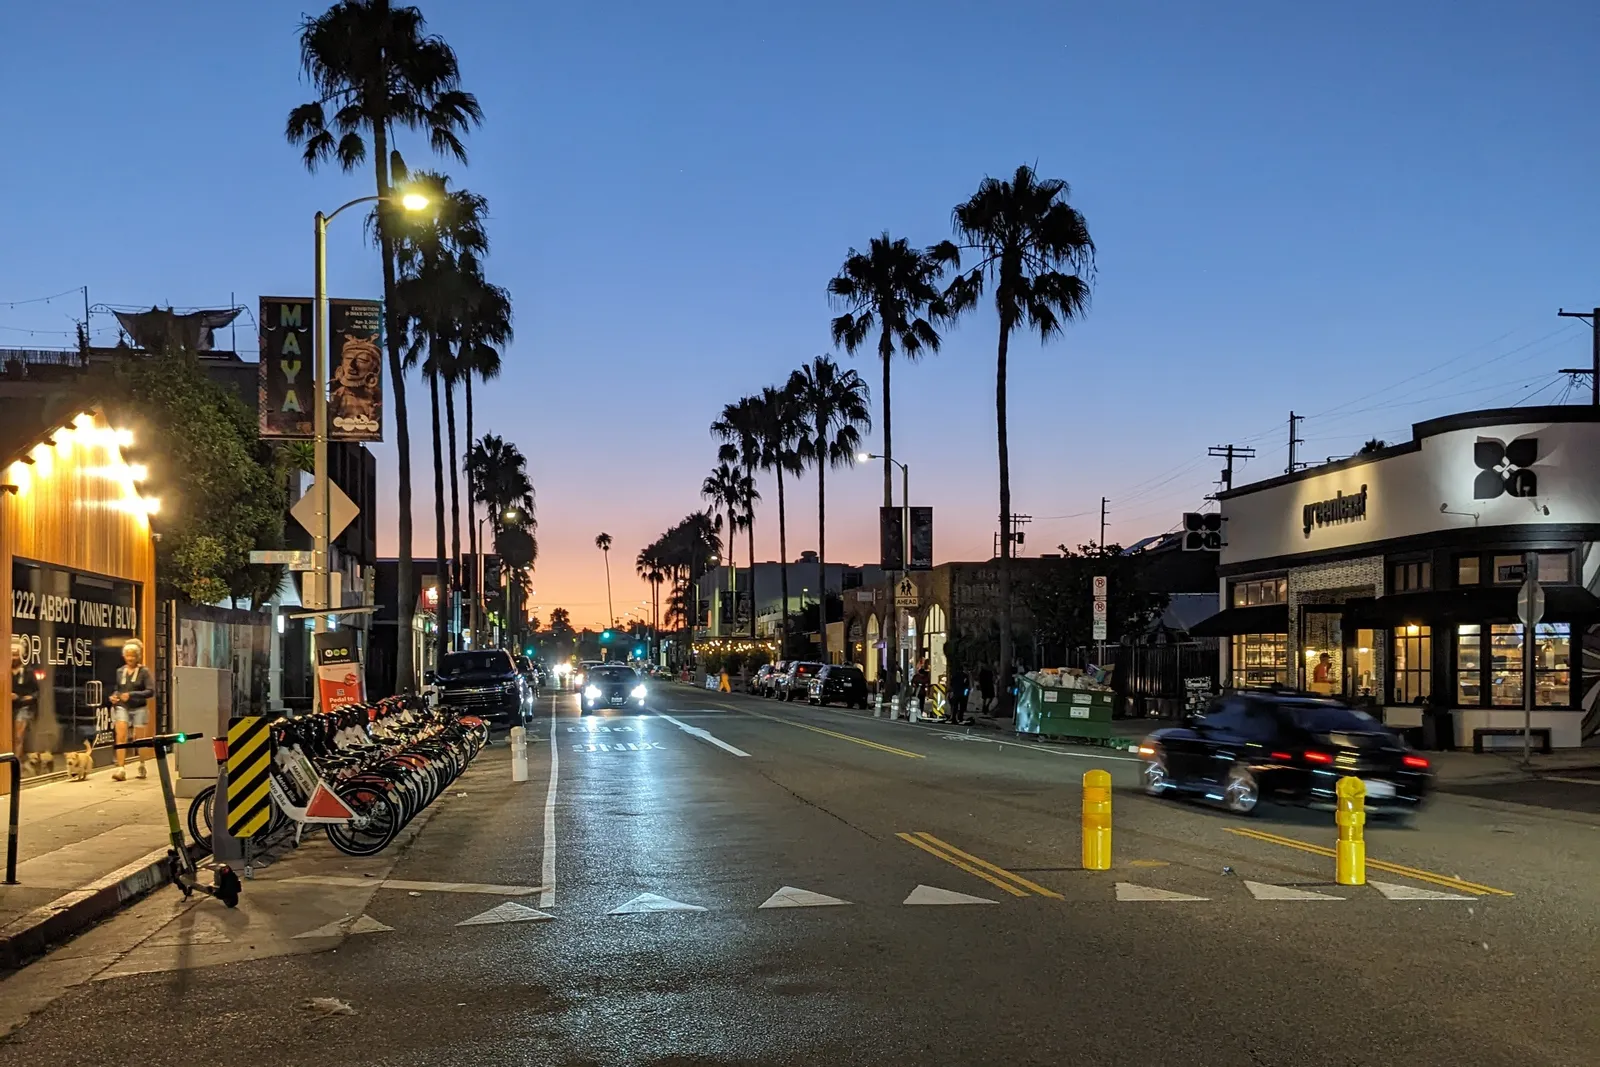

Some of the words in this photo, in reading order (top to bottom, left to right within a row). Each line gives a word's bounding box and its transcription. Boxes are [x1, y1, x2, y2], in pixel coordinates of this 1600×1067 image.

[280, 304, 302, 413] MAYA
[1303, 484, 1367, 537] greenleaf
[12, 589, 36, 620] 1222
[40, 594, 76, 623] ABBOT
[80, 600, 113, 628] KINNEY
[115, 606, 137, 630] BLVD
[48, 636, 92, 667] LEASE
[276, 774, 289, 791] Metro
[287, 790, 297, 802] Bike
[292, 765, 304, 781] Metro
[277, 793, 287, 806] Bike
